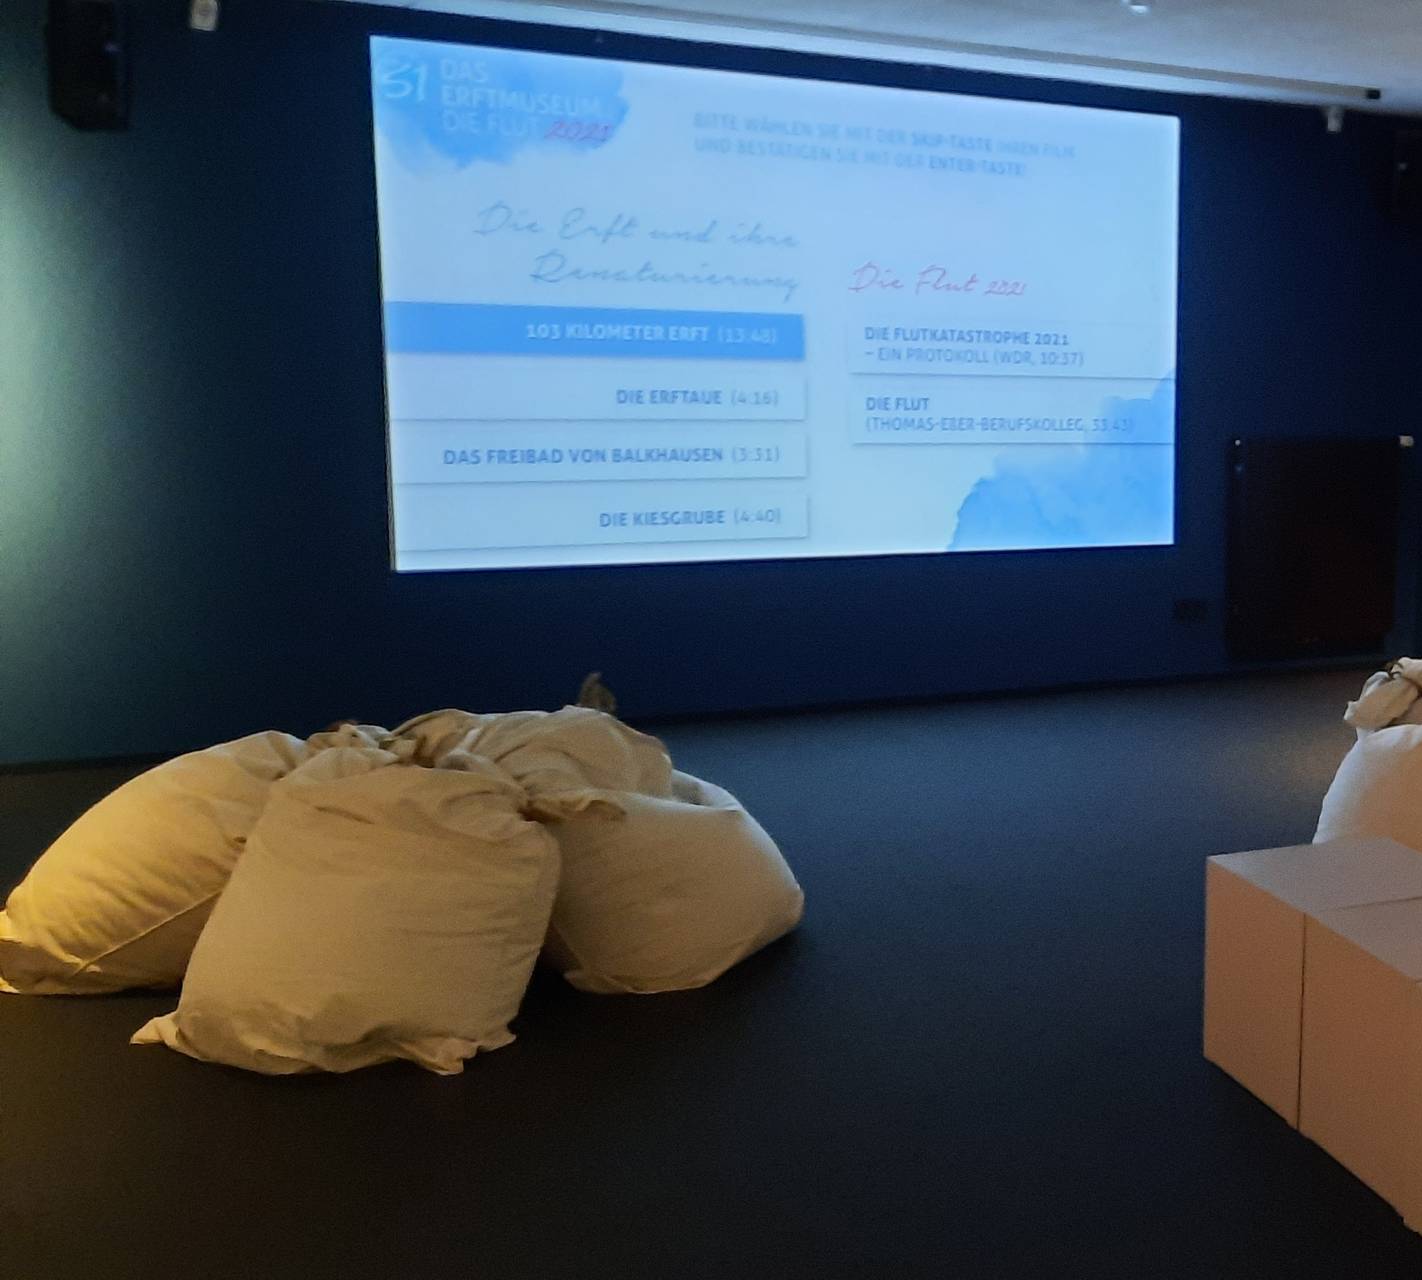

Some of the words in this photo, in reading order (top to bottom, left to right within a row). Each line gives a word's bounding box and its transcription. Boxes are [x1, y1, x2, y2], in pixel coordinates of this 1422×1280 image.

[440, 58, 490, 84] DAS
[440, 84, 602, 117] ERFTMUSEUM
[441, 109, 481, 136] DIE
[486, 112, 540, 138] FLUT
[693, 112, 738, 131] BITTE
[876, 128, 907, 144] DER
[910, 131, 993, 153] SKIP-TASTE
[694, 137, 732, 154] UND
[736, 137, 832, 161] BESTÄTIGEN
[472, 201, 544, 237] Die
[558, 206, 638, 245] Erft
[646, 218, 719, 243] und
[726, 221, 800, 248] ihre
[528, 248, 800, 304] Renaturierung
[847, 261, 904, 294] Die
[914, 264, 980, 297] Flut
[525, 323, 561, 340] 103
[564, 323, 665, 341] KILOMETER
[667, 325, 711, 342] ERFT
[865, 326, 890, 341] DIE
[894, 327, 1031, 346] FLUTKATASTROPHE
[1034, 332, 1071, 346] 2021
[877, 347, 902, 362] EIN
[905, 348, 990, 365] PROTOKOLL
[616, 388, 644, 405] DIE
[648, 388, 723, 406] ERFTAUE
[866, 396, 891, 411] DIE
[894, 397, 931, 412] FLUT
[442, 448, 481, 465] DAS
[485, 447, 564, 464] FREIBAD
[567, 446, 607, 463] VON
[610, 446, 724, 463] BALKHAUSEN
[598, 511, 629, 528] DIE
[632, 509, 727, 527] KIESGRUBE
